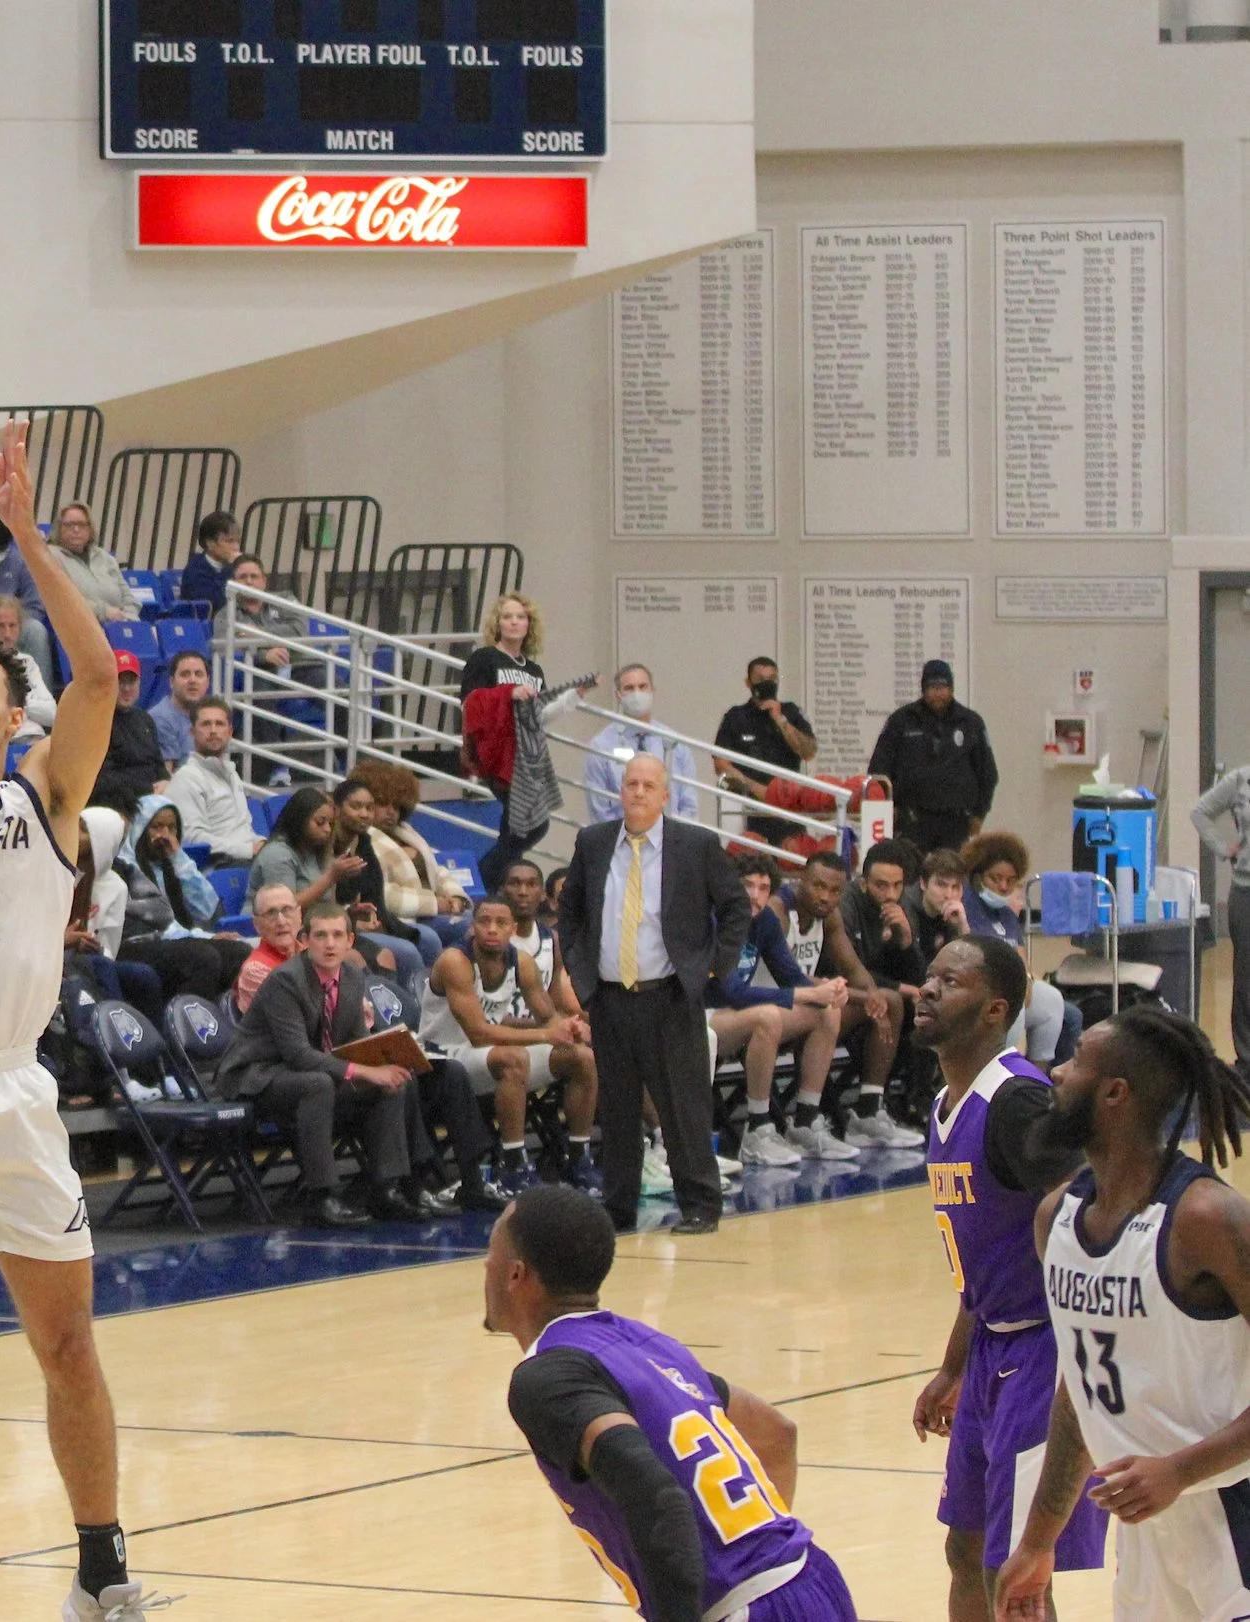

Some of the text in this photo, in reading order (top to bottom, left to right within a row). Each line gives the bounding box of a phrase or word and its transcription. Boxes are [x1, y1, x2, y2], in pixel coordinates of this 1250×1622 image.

[135, 43, 196, 62] FOULS
[222, 44, 273, 63] T.O.L.
[298, 44, 426, 65] PLAYER FOUL
[448, 46, 499, 65] T.O.L.
[523, 46, 583, 66] FOULS
[136, 129, 197, 148] SCORE
[327, 130, 393, 150] MATCH
[523, 132, 584, 151] SCORE
[816, 235, 953, 247] All Time Assist Leaders
[1003, 231, 1155, 242] Three Point Shot Leaders
[812, 586, 961, 599] All Time Leading Rebounders
[1049, 1264, 1148, 1318] AUGUSTA
[1071, 1326, 1126, 1415] 13
